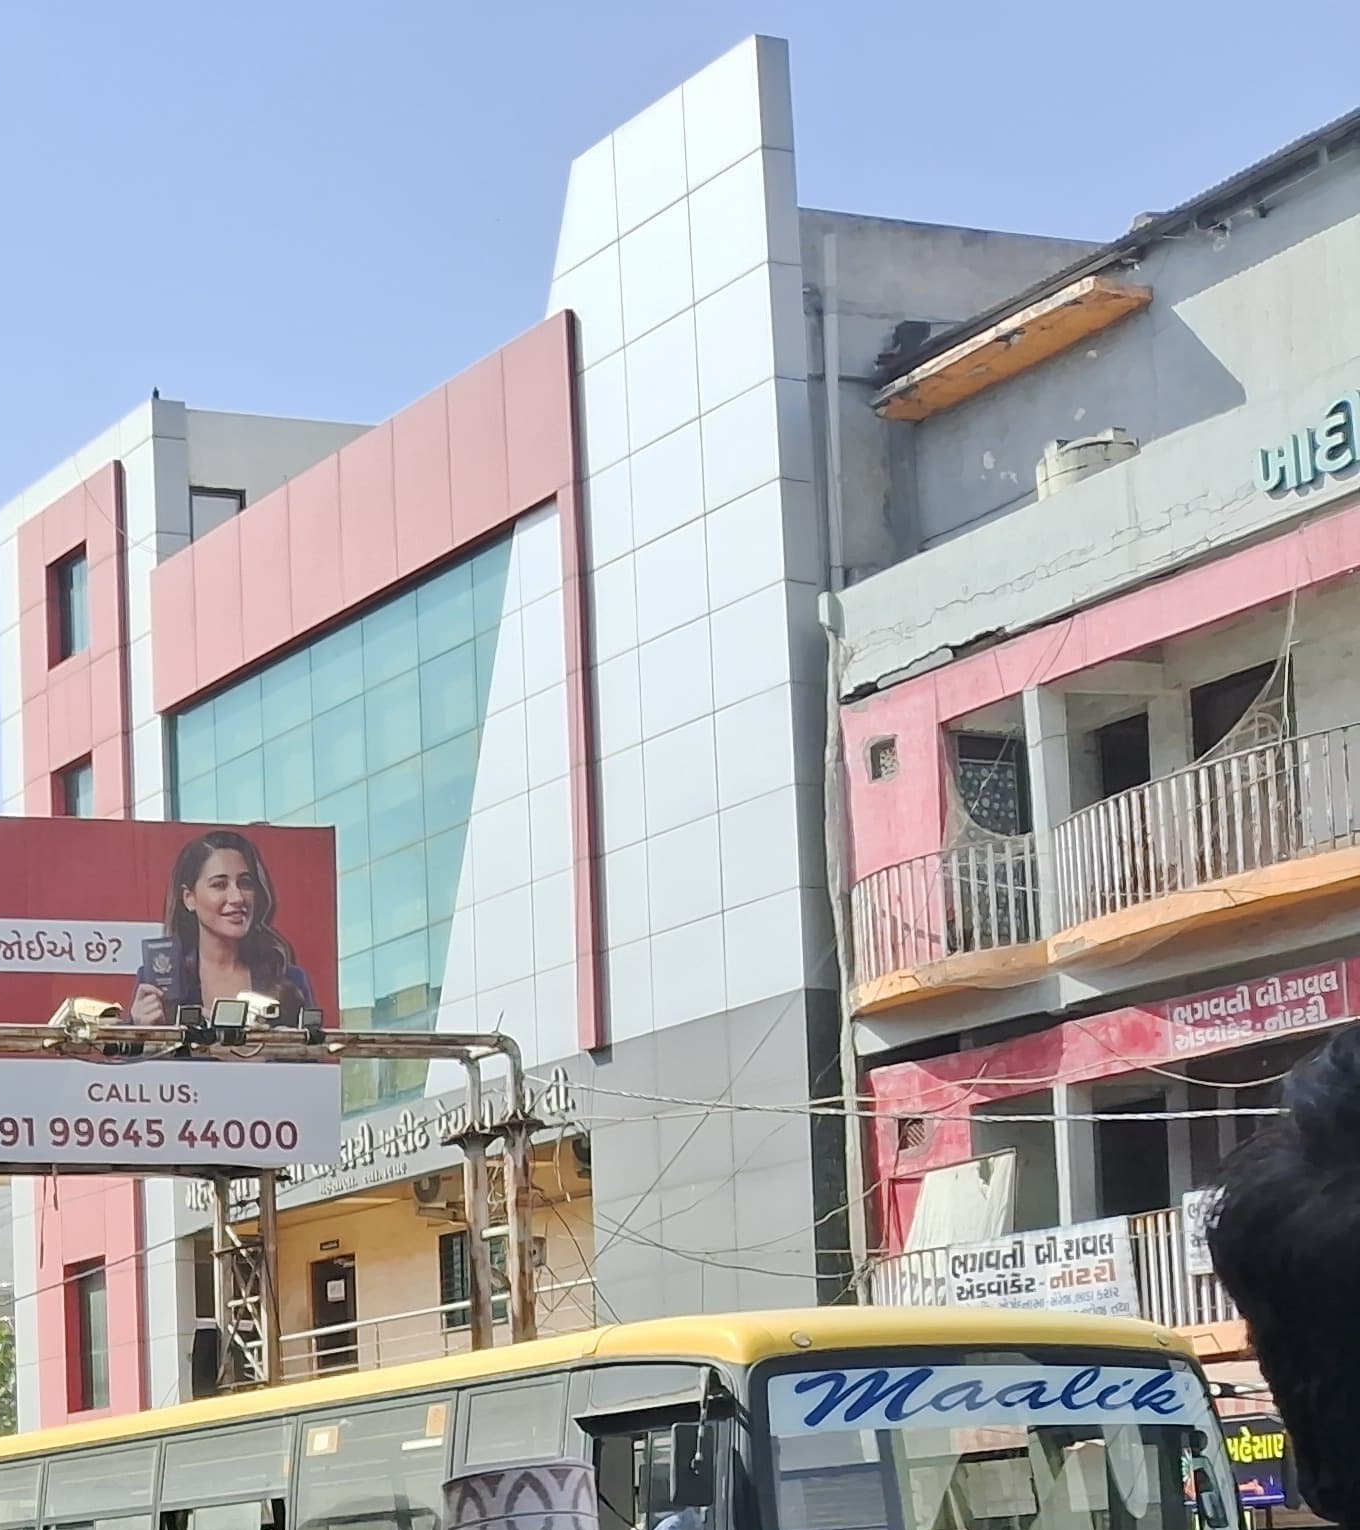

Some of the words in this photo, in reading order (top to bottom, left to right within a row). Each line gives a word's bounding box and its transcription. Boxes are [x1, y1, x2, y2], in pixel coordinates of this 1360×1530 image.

[84, 931, 123, 964] છે?
[1173, 985, 1252, 1025] ભગવતી
[87, 1083, 151, 1103] CALL
[159, 1084, 199, 1104] US:
[49, 1117, 165, 1149] 99645
[177, 1119, 298, 1151] 44000
[951, 1240, 1026, 1279] ભગવતી
[794, 1366, 1186, 1427] Maalik
